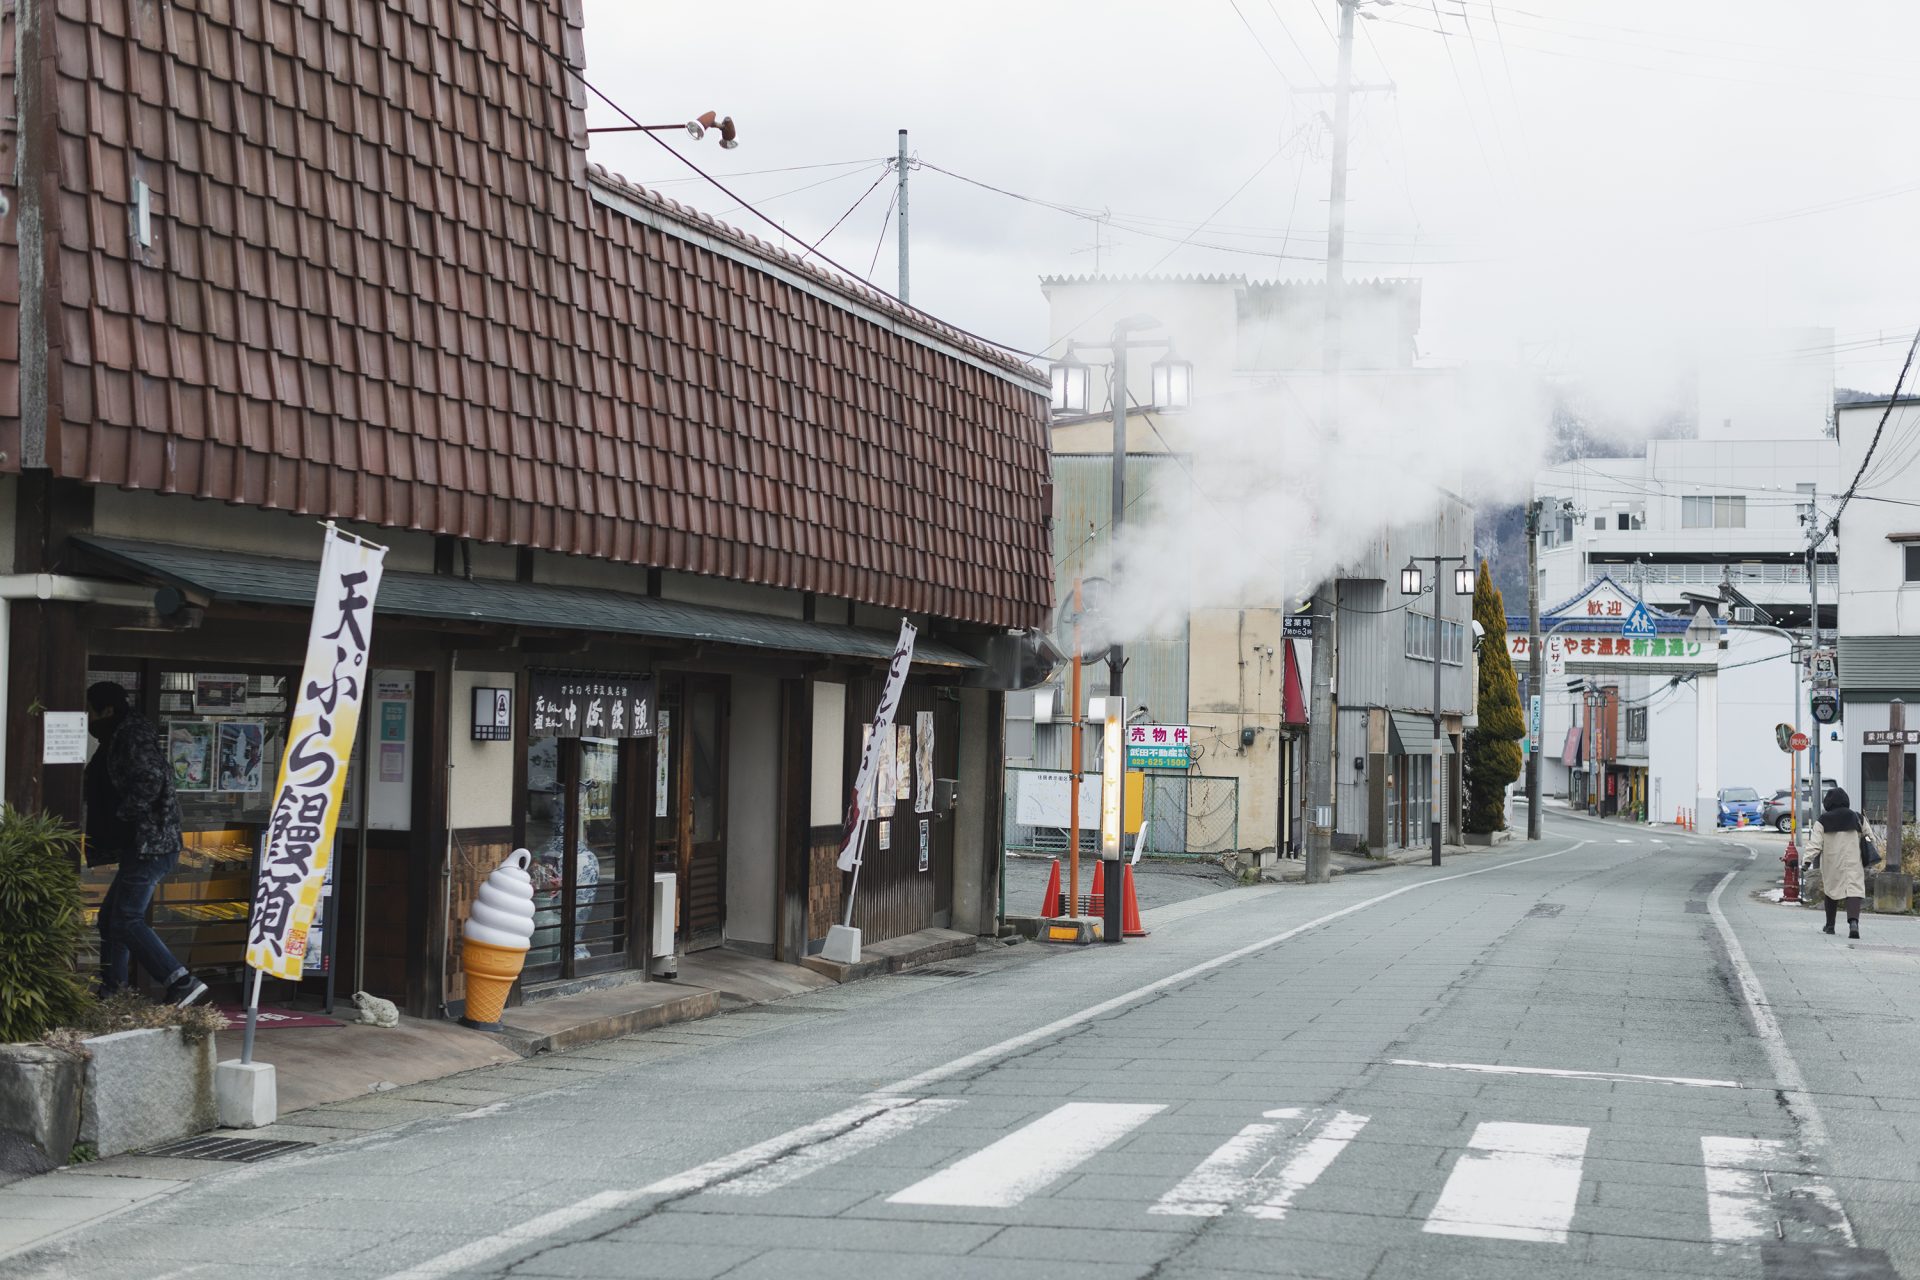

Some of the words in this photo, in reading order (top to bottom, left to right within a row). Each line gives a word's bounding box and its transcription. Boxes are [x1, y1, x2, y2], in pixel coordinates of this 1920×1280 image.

[1588, 601, 1623, 616] 歓迎
[1512, 636, 1701, 657] かやま温泉新湯通り
[1131, 727, 1188, 743] 売物件
[249, 570, 369, 957] 天ぷら饅頭
